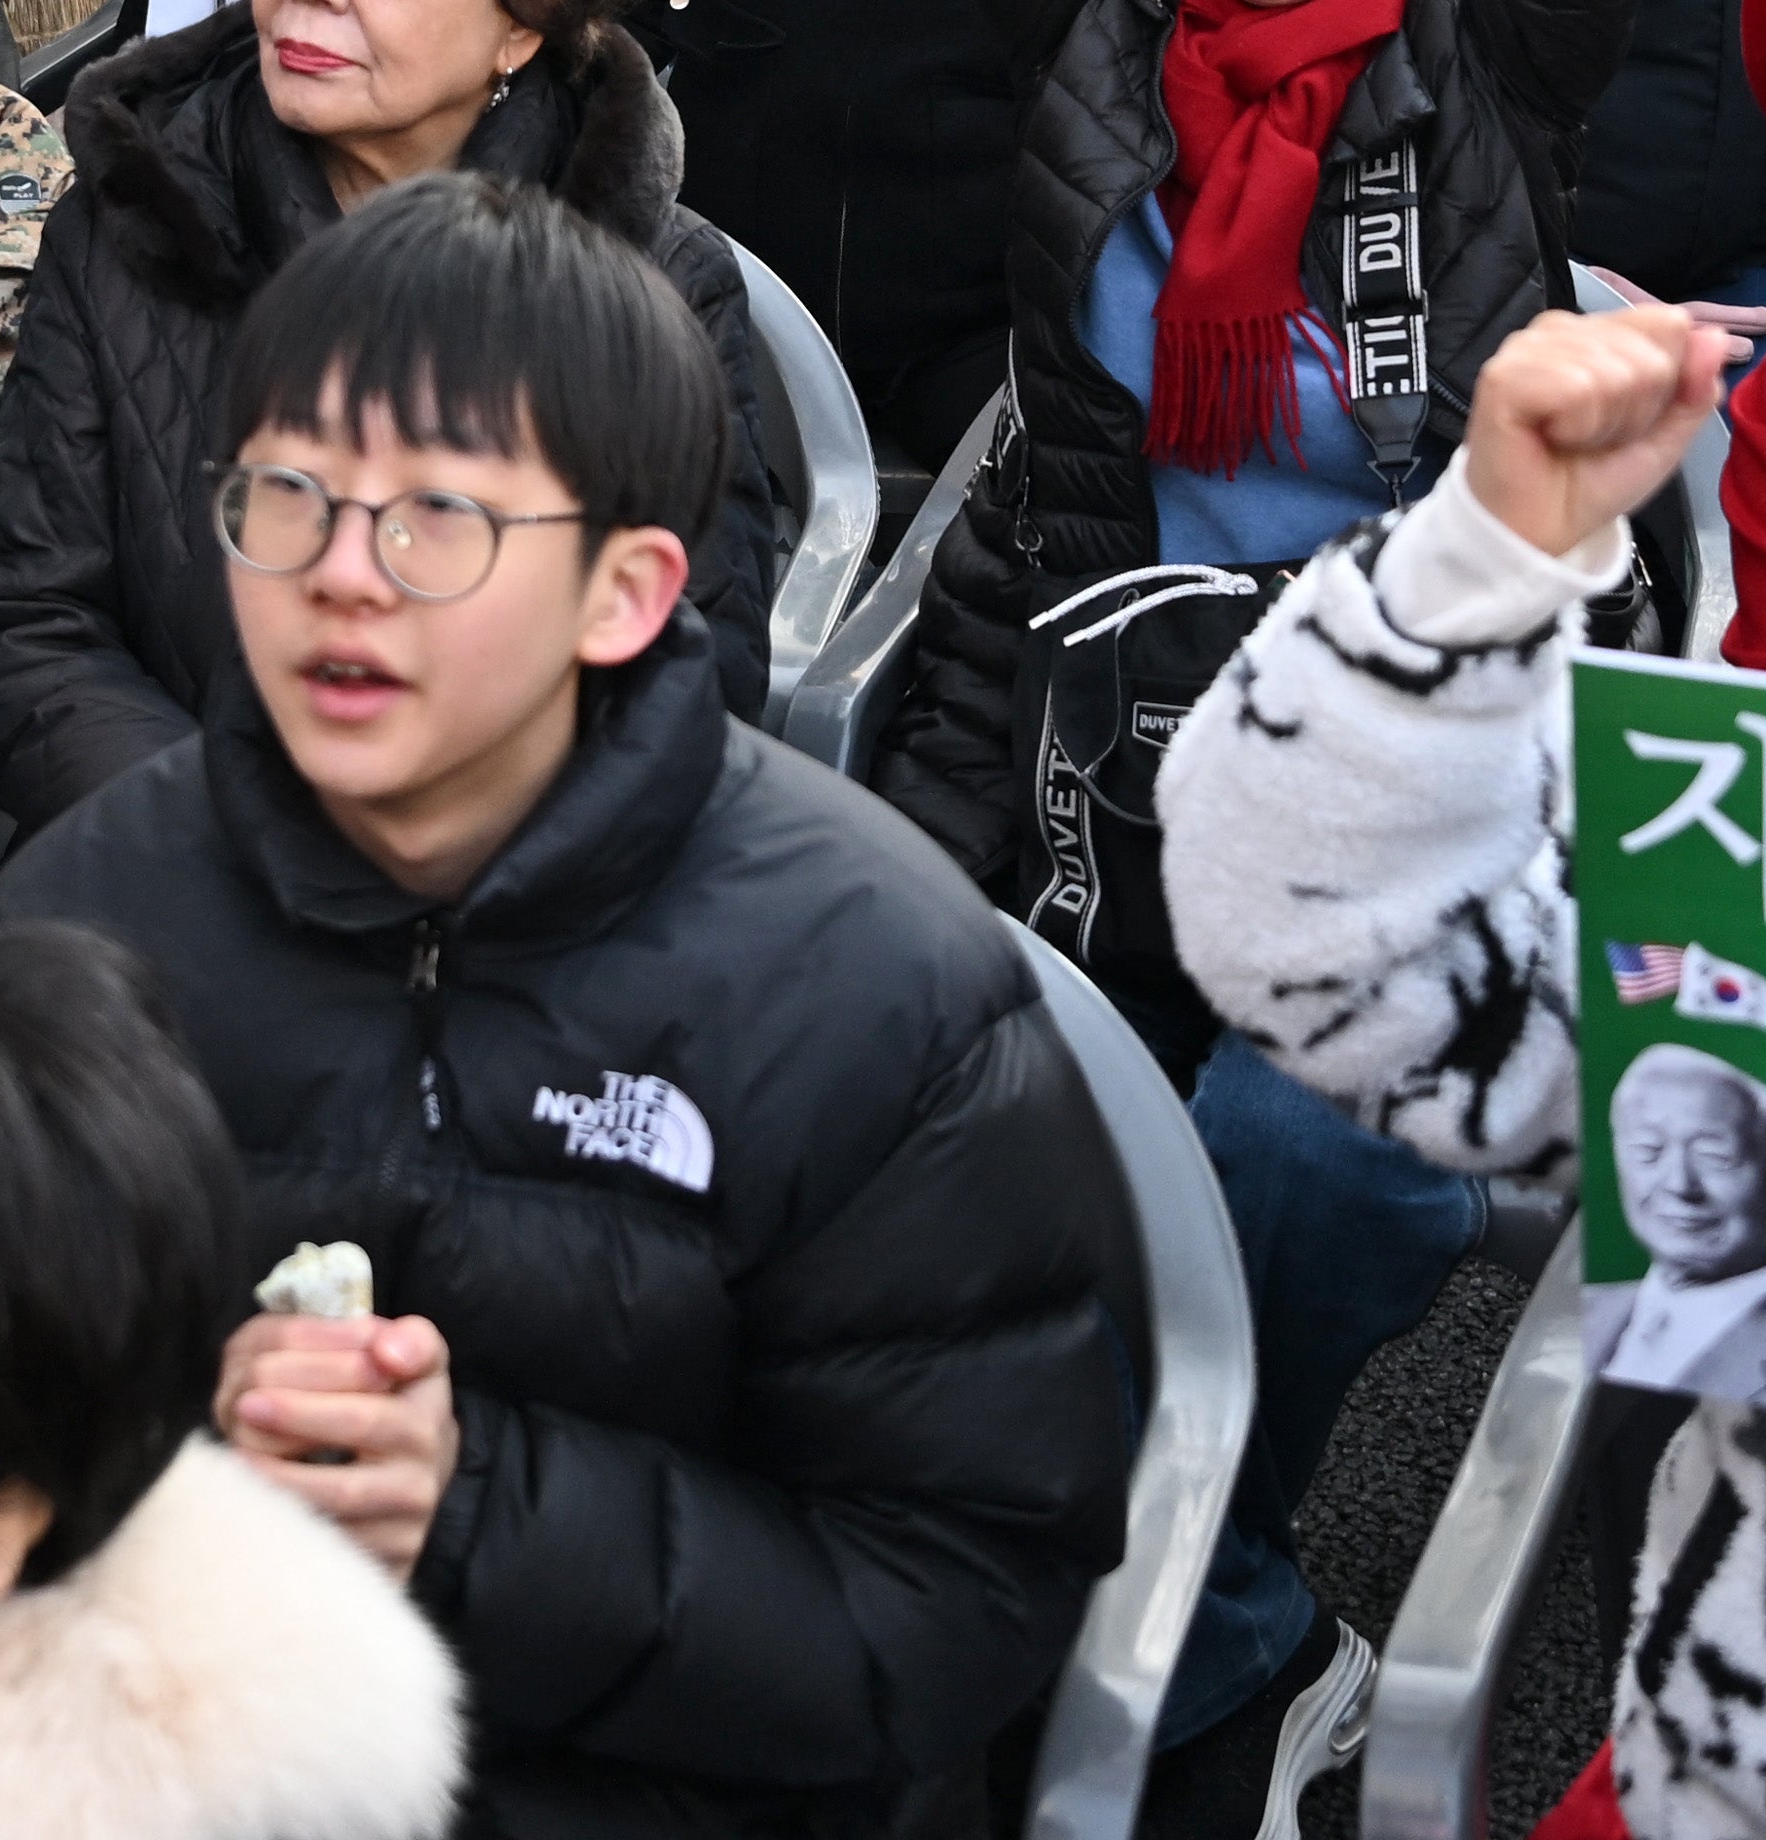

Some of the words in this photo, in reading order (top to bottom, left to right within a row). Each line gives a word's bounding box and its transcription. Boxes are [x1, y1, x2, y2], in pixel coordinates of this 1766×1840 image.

[530, 1084, 663, 1135] NORTH
[598, 1068, 672, 1105] THE
[563, 1118, 655, 1165] FACE
